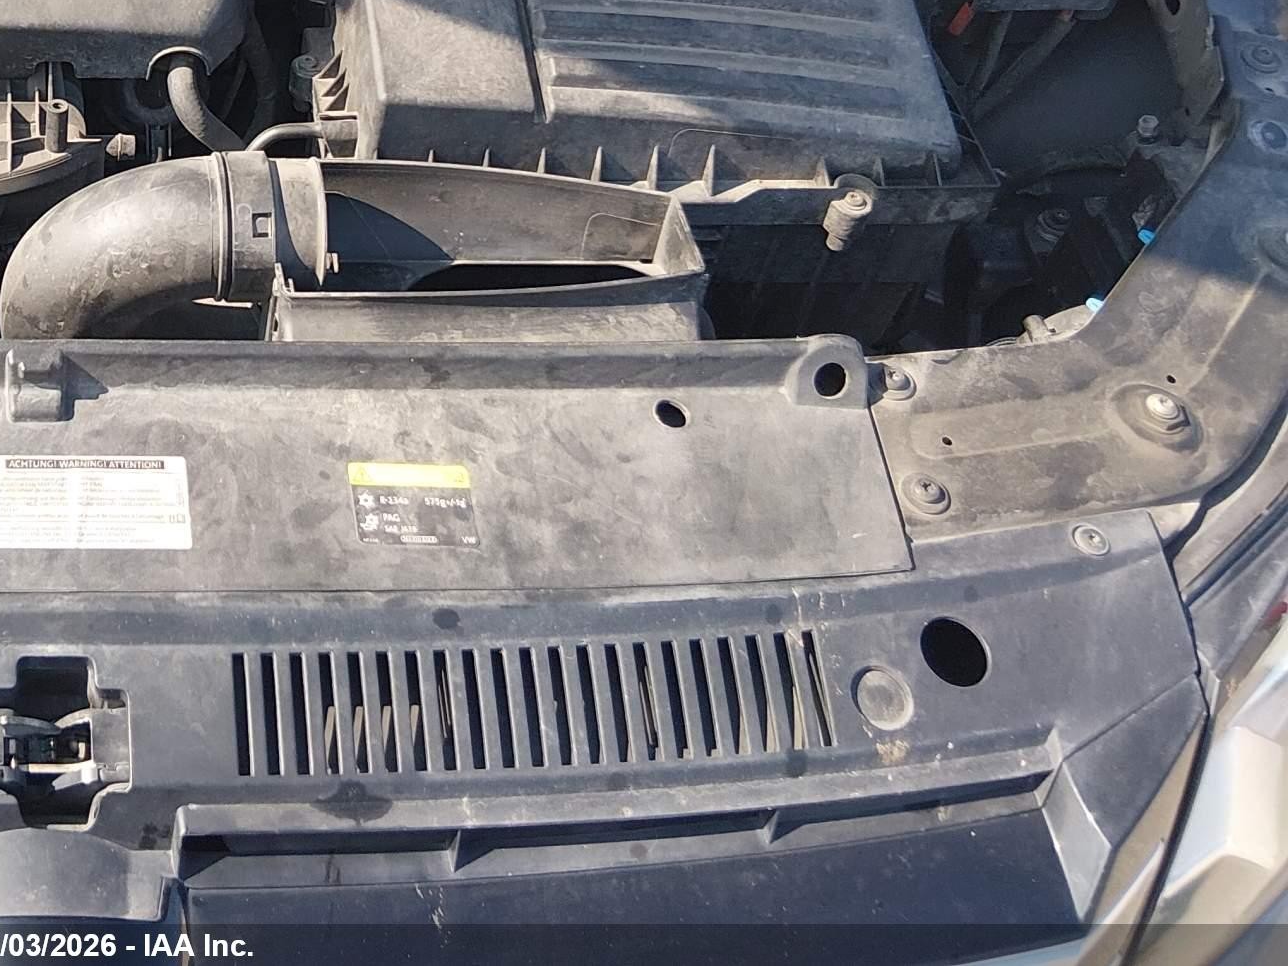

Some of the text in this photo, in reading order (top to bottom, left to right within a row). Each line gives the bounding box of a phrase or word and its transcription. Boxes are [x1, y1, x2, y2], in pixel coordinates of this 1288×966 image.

[8, 459, 162, 469] ACHTUNG! WARNING! ATTENTION!
